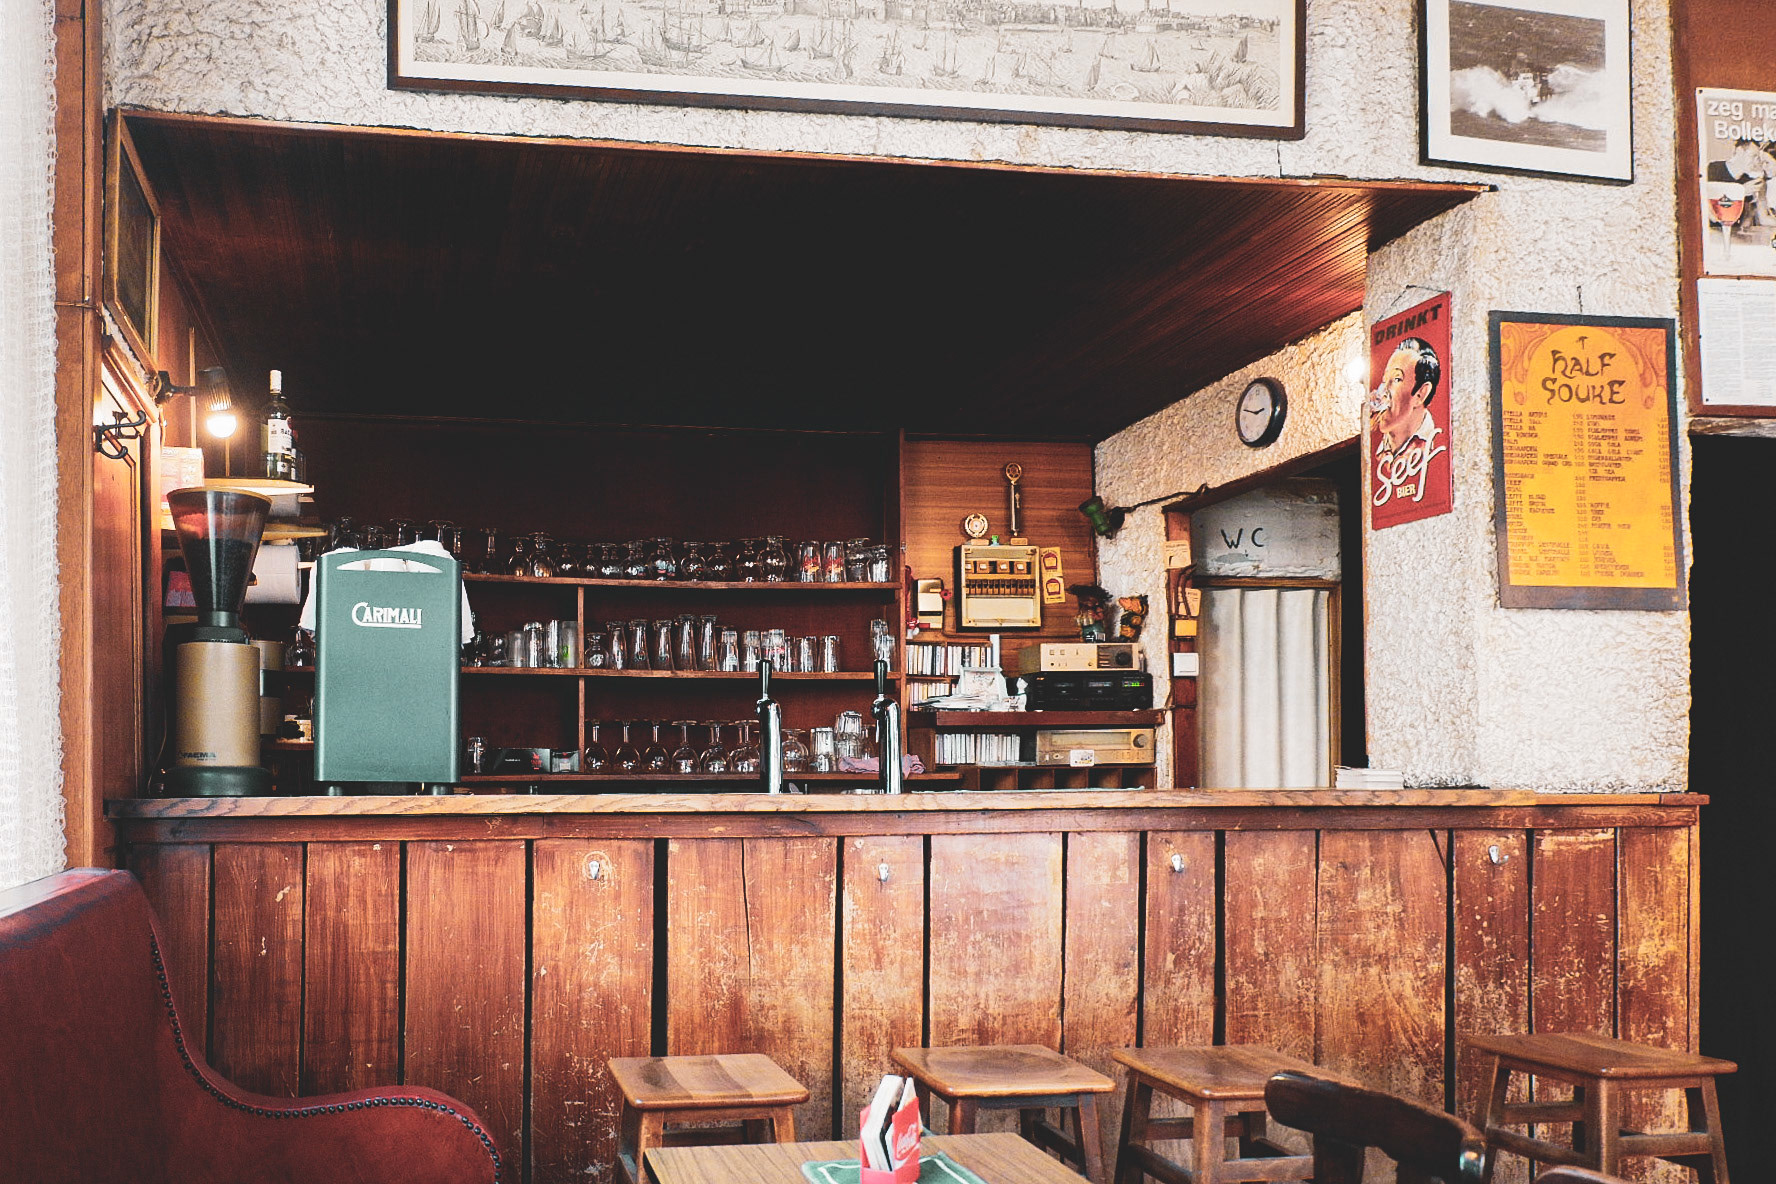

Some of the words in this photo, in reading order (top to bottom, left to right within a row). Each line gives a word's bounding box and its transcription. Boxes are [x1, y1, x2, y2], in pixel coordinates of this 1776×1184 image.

[1707, 100, 1744, 121] zeg
[1374, 303, 1443, 347] DRINKT
[1541, 377, 1626, 405] SOUKE
[1373, 427, 1447, 507] Seef
[1396, 483, 1416, 500] BIER
[351, 602, 422, 629] CARIMALI
